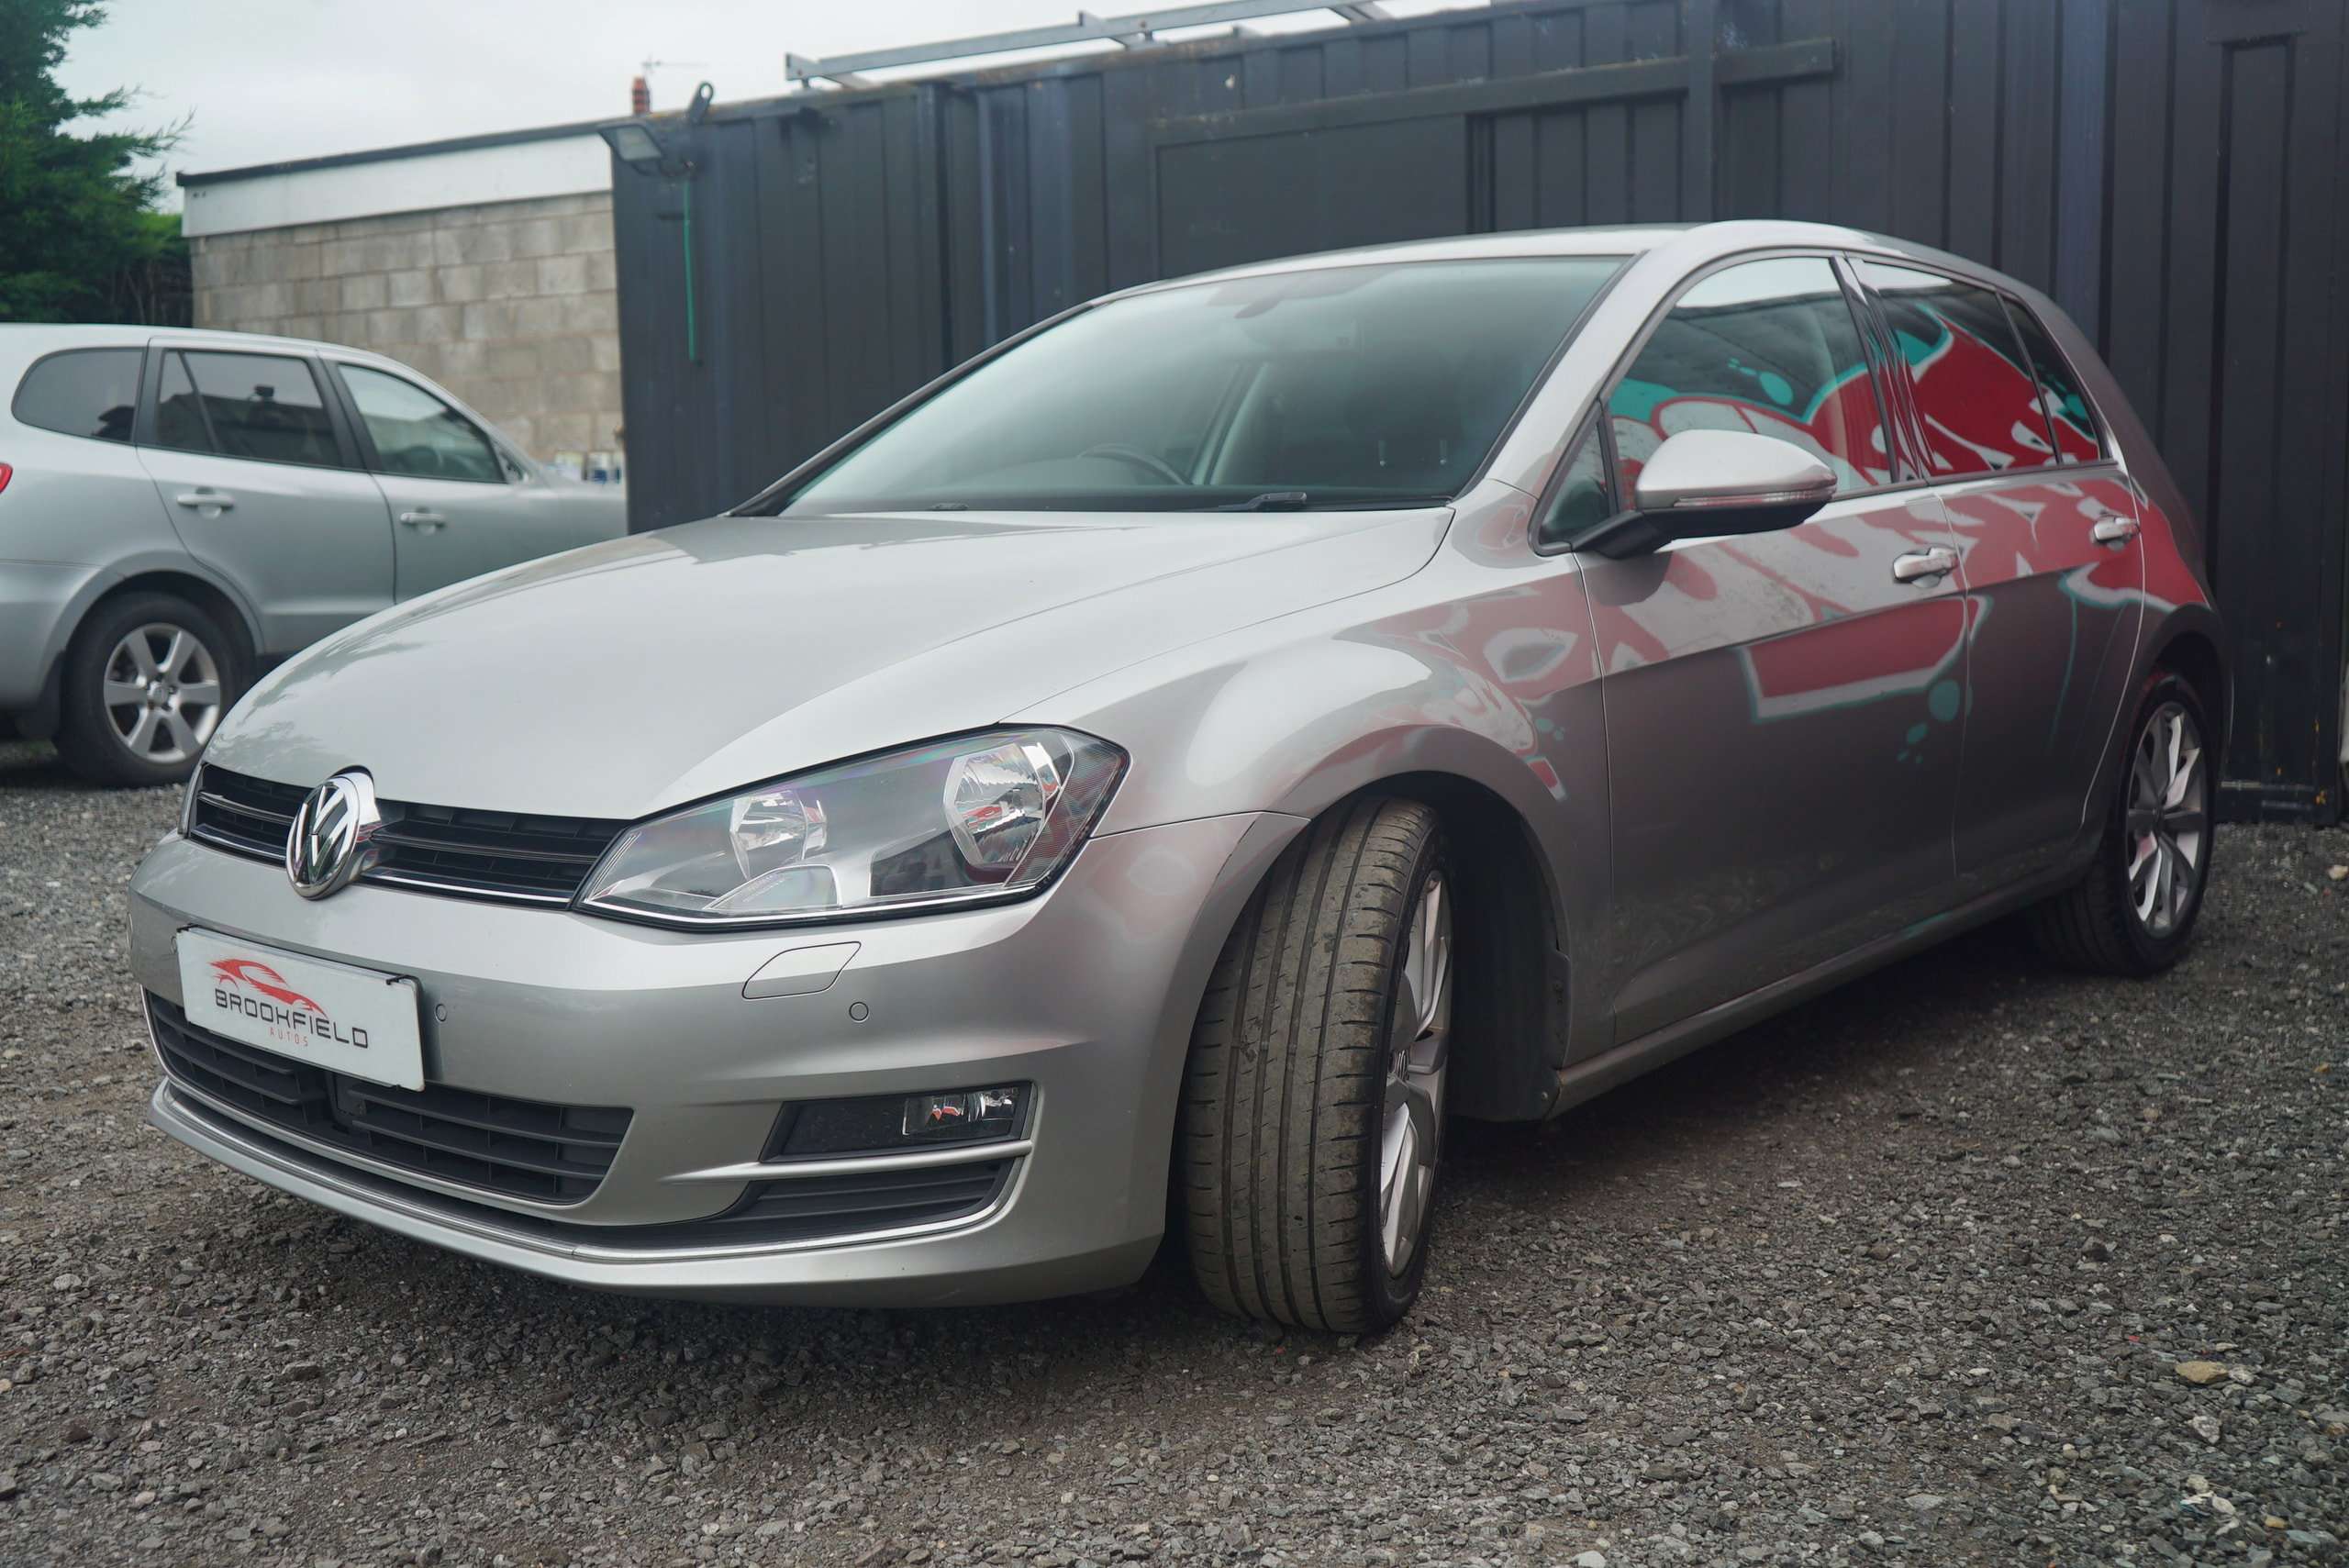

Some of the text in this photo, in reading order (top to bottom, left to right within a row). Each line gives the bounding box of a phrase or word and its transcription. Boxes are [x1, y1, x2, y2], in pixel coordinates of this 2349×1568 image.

[291, 782, 352, 888] VW
[215, 988, 368, 1049] BROOKFIELD
[269, 1027, 309, 1048] AUTOS
